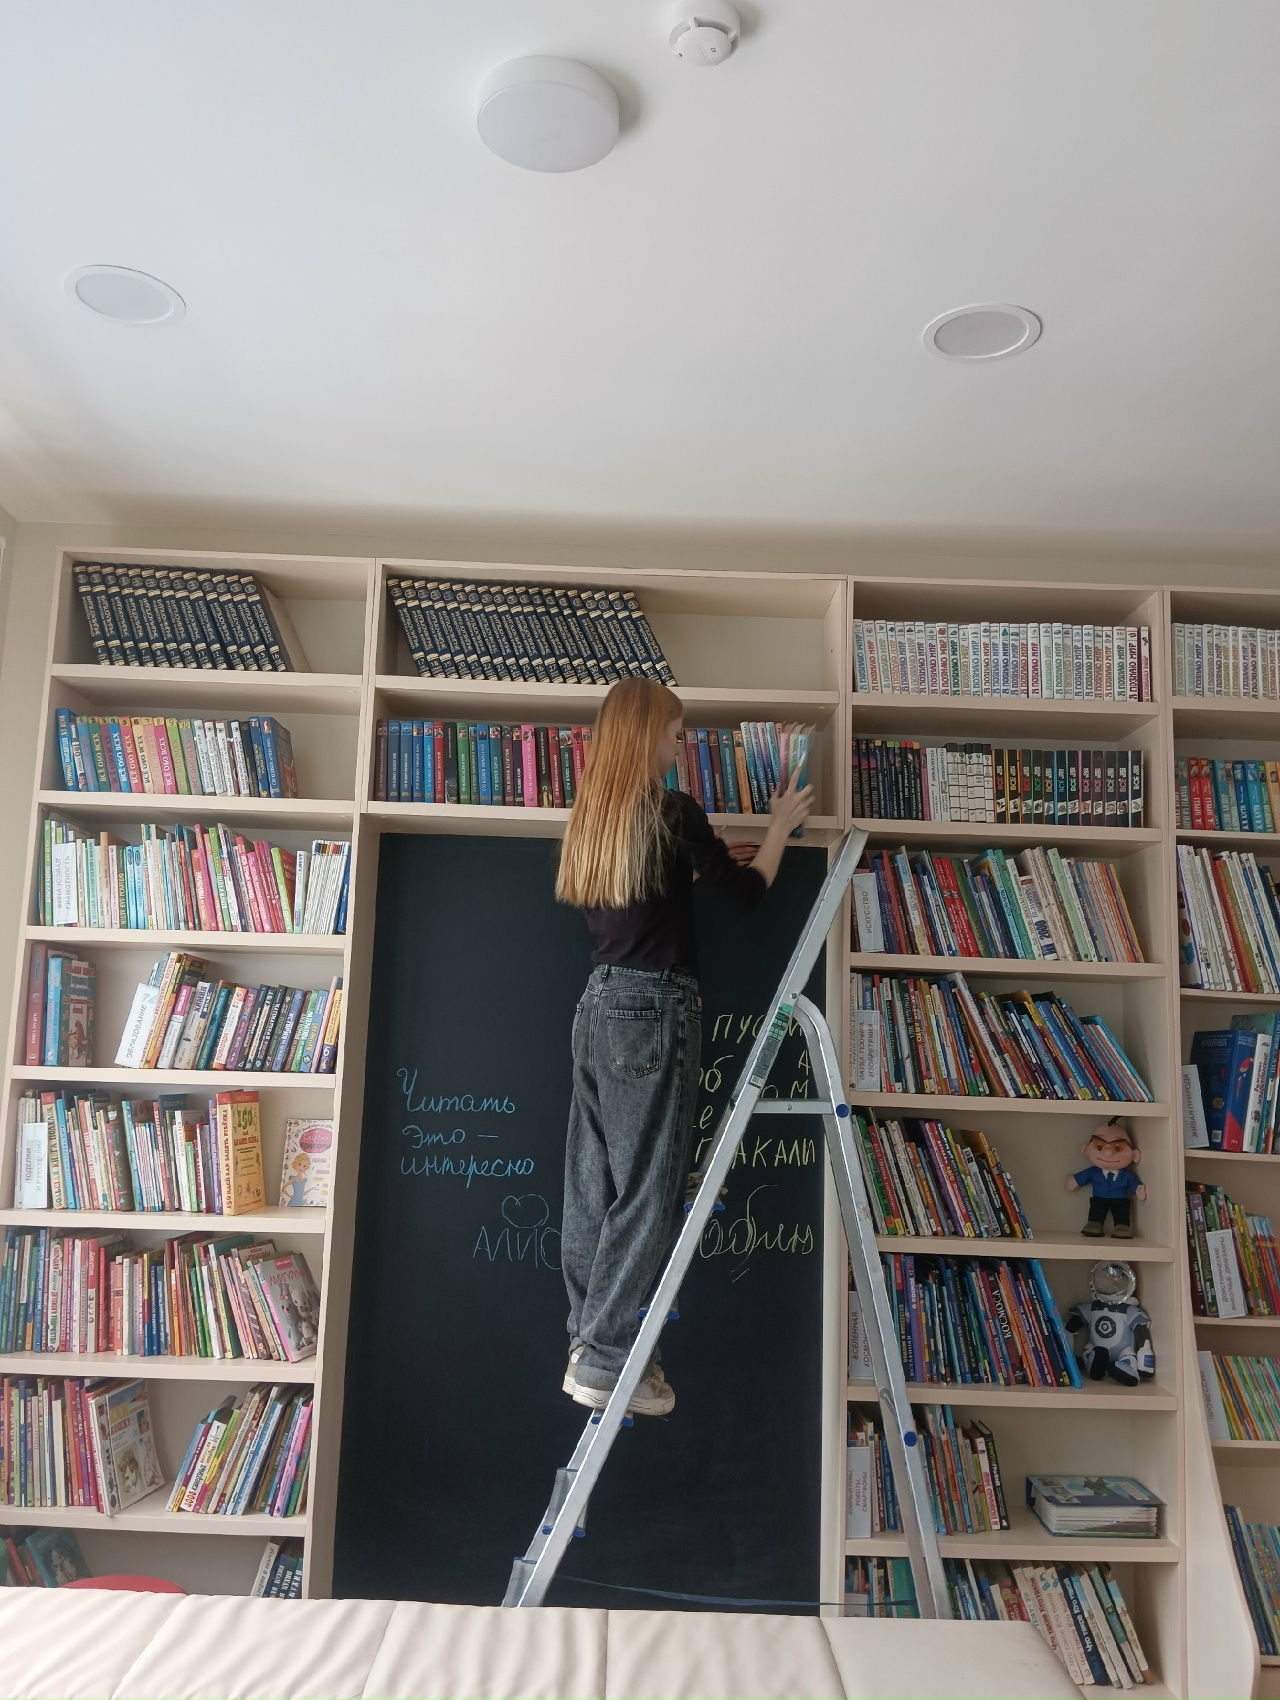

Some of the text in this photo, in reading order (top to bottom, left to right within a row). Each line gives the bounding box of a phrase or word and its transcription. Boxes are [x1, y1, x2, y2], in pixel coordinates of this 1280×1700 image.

[861, 891, 872, 934] ИСКУССТВО
[126, 1004, 147, 1058] ОБРАЗОВАНИЕ
[397, 1068, 516, 1115] Читать
[1183, 1073, 1199, 1138] ЖИВАЯ ПРИРОДА
[237, 1109, 253, 1130] 150
[402, 1125, 466, 1148] Это
[50, 1142, 60, 1168] КНИГА
[401, 1155, 535, 1188] интересно
[473, 1226, 562, 1270] АЛИС
[993, 1290, 1011, 1339] КОСМОСА
[1063, 1577, 1076, 1600] такое
[1077, 1614, 1088, 1637] такое
